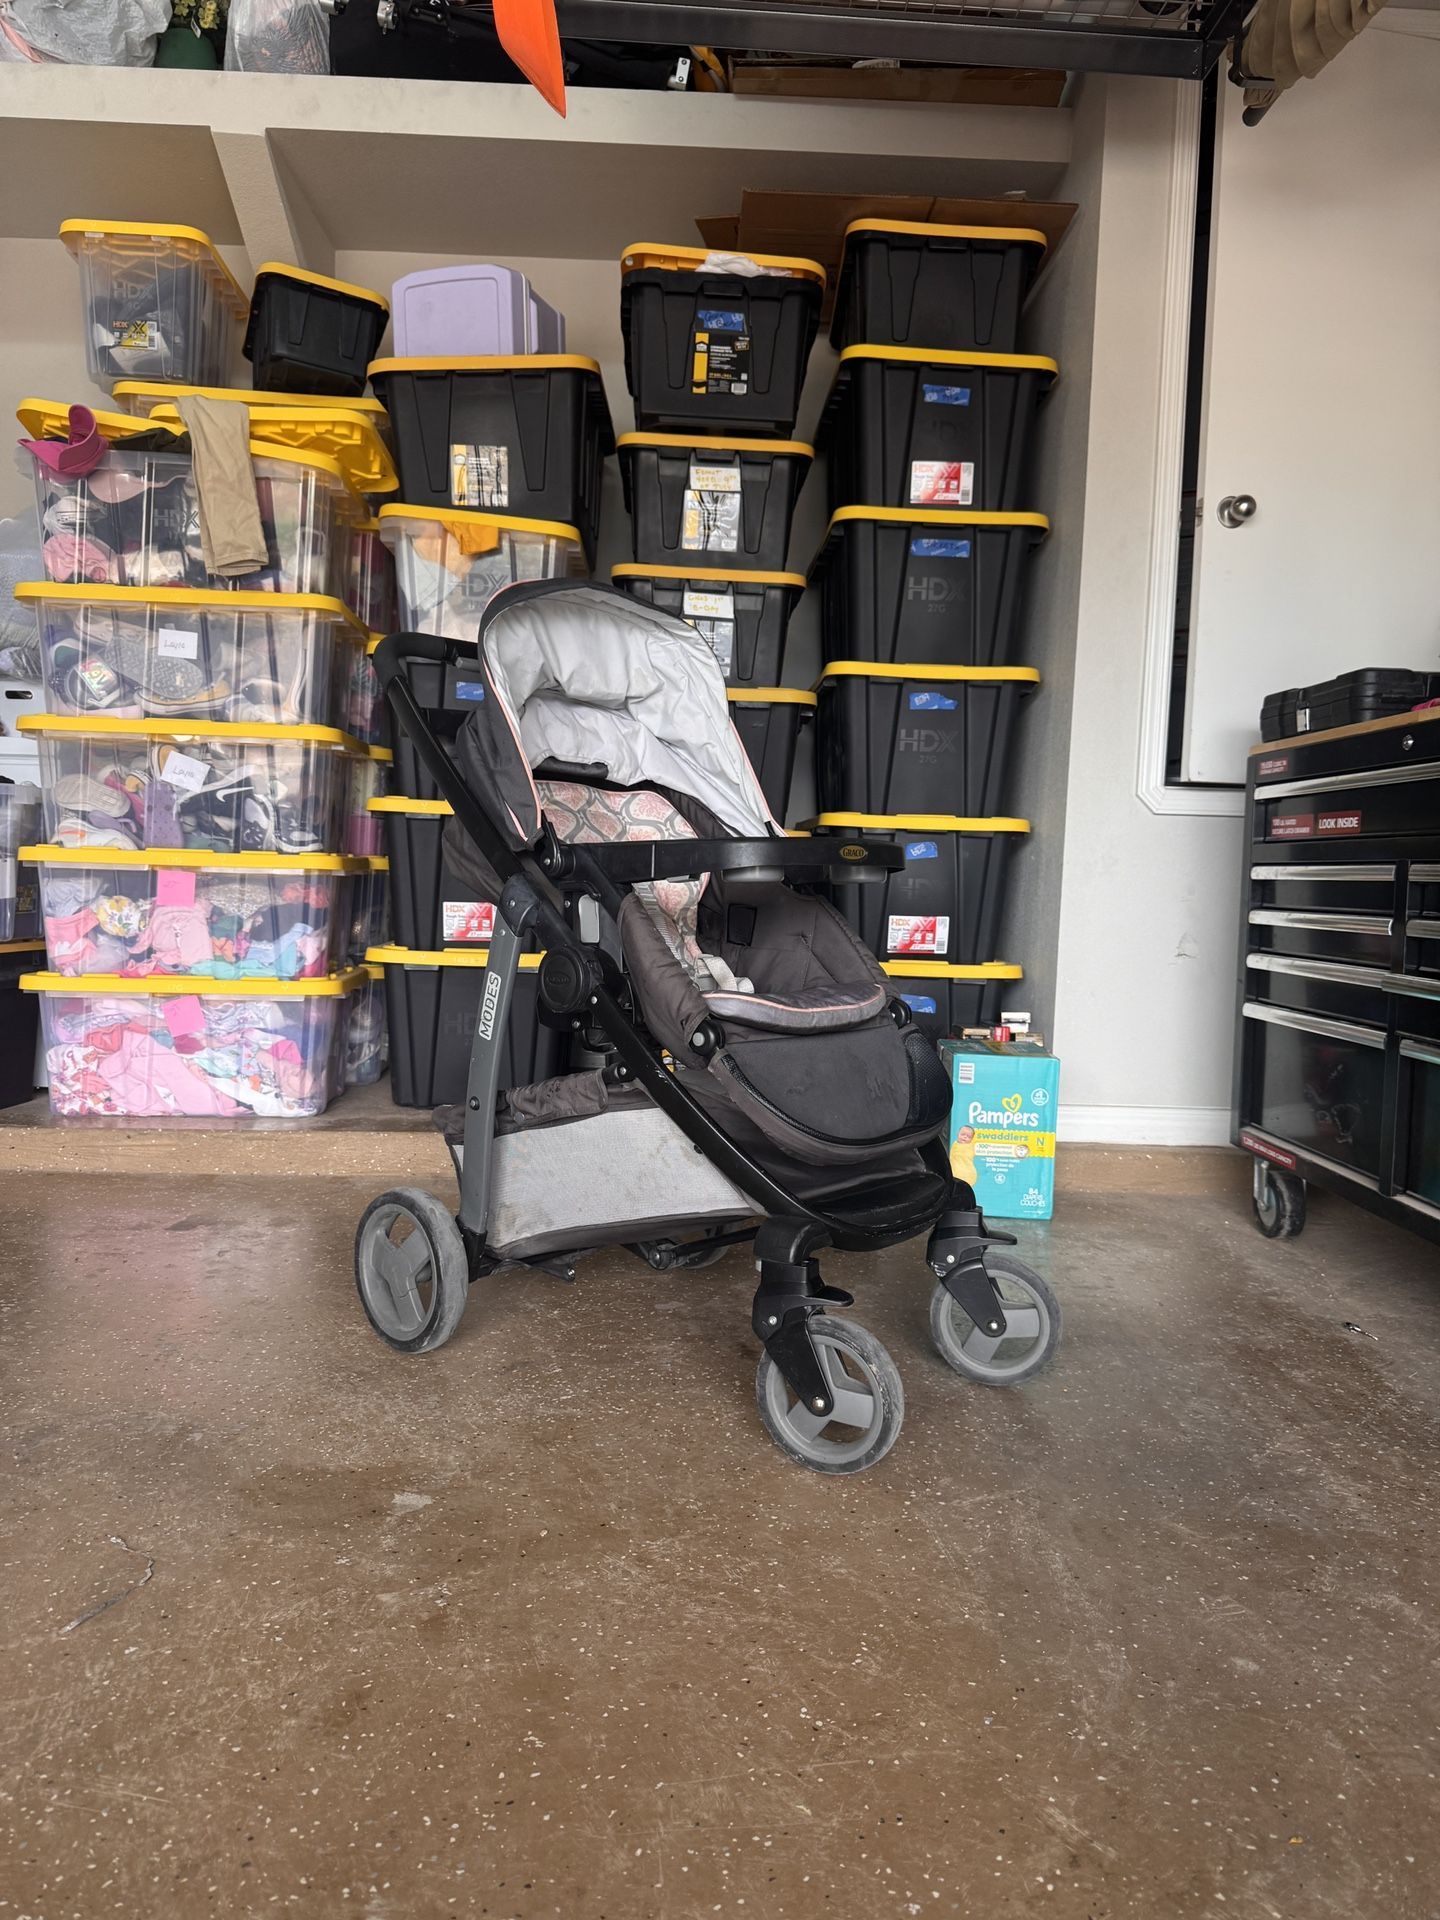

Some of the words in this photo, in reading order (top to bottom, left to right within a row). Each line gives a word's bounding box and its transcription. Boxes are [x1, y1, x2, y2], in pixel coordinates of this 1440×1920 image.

[908, 577, 966, 601] HDX
[899, 729, 959, 753] HDX
[1318, 818, 1336, 829] LOOK
[1336, 817, 1360, 828] INSIDE
[842, 847, 865, 858] GRACO
[445, 904, 466, 913] HDX
[891, 918, 912, 927] HDX
[479, 974, 500, 1038] MODES
[968, 1101, 1040, 1129] Pampers
[976, 1132, 1029, 1142] swaddlers
[1037, 1137, 1046, 1146] N
